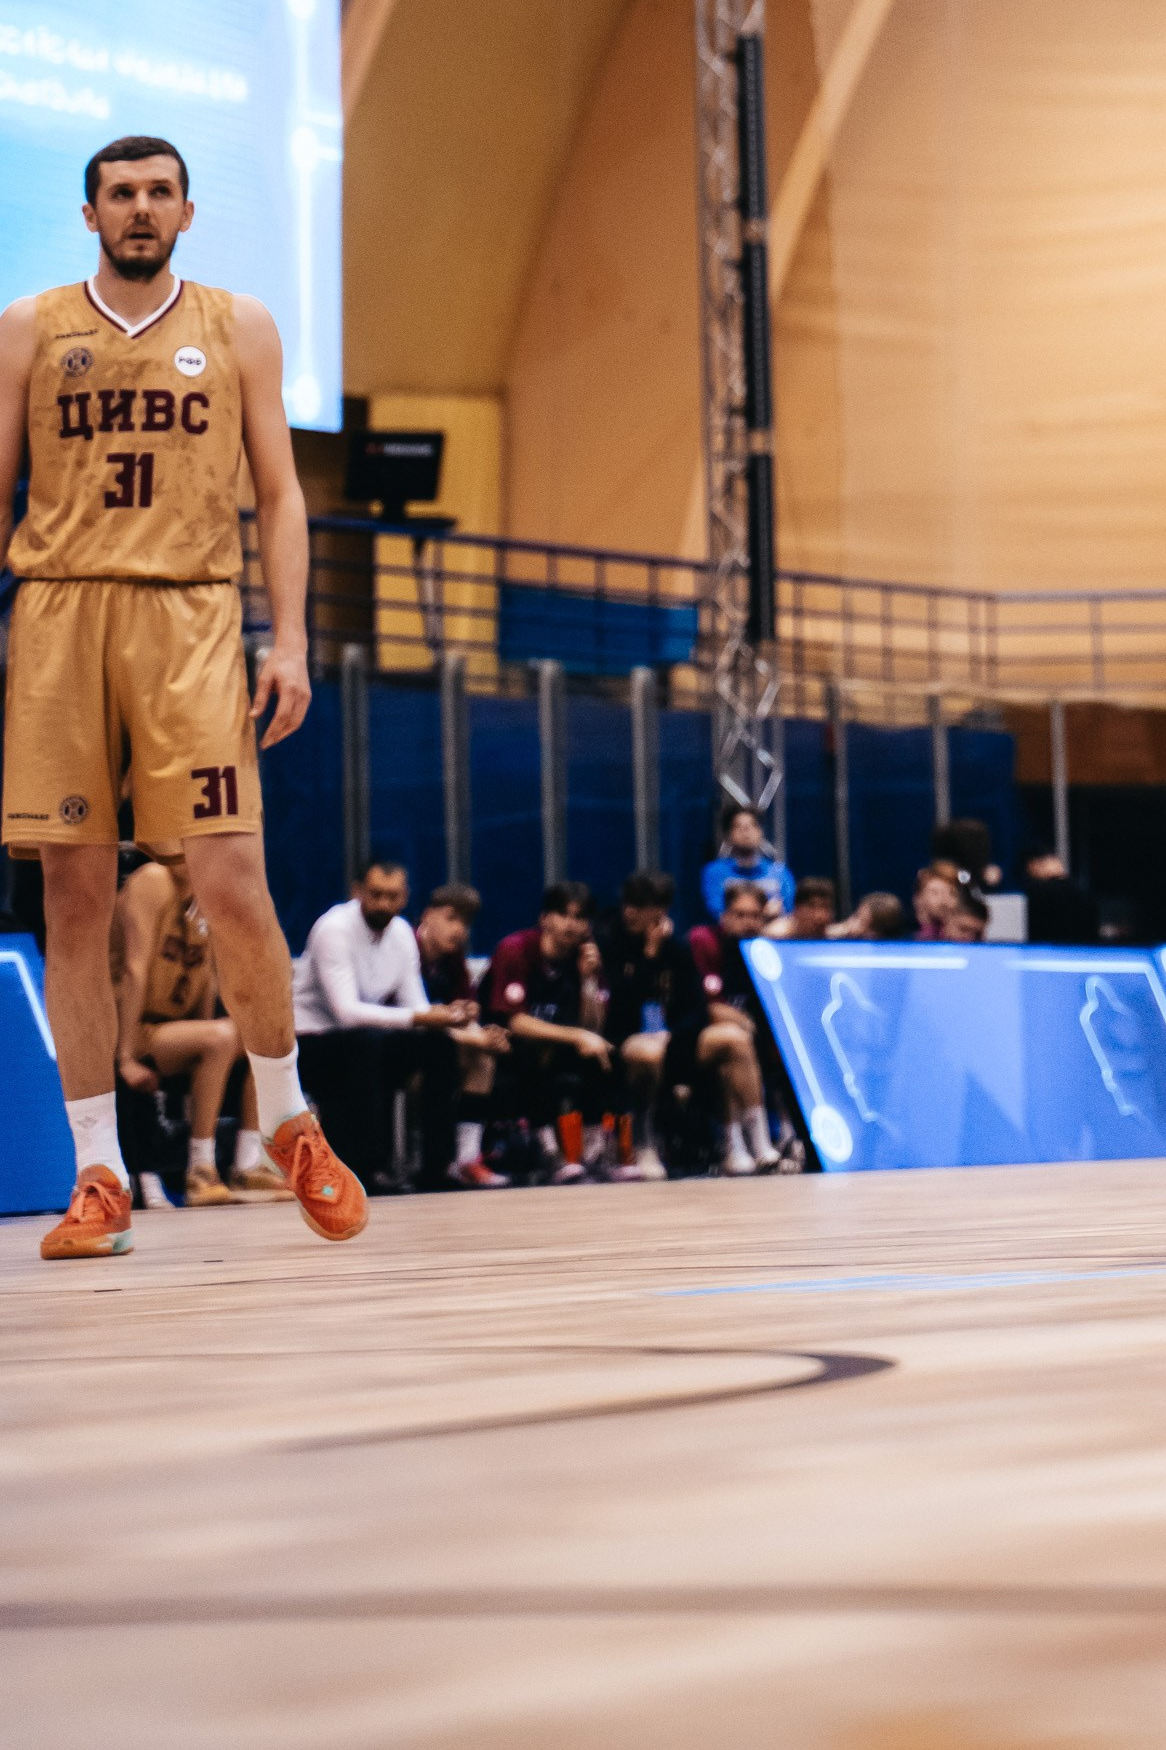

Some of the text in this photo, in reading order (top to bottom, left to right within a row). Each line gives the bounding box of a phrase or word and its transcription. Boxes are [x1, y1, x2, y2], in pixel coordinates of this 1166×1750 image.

[56, 388, 210, 441] ЦИВС
[104, 452, 154, 508] 31
[190, 765, 238, 819] 31
